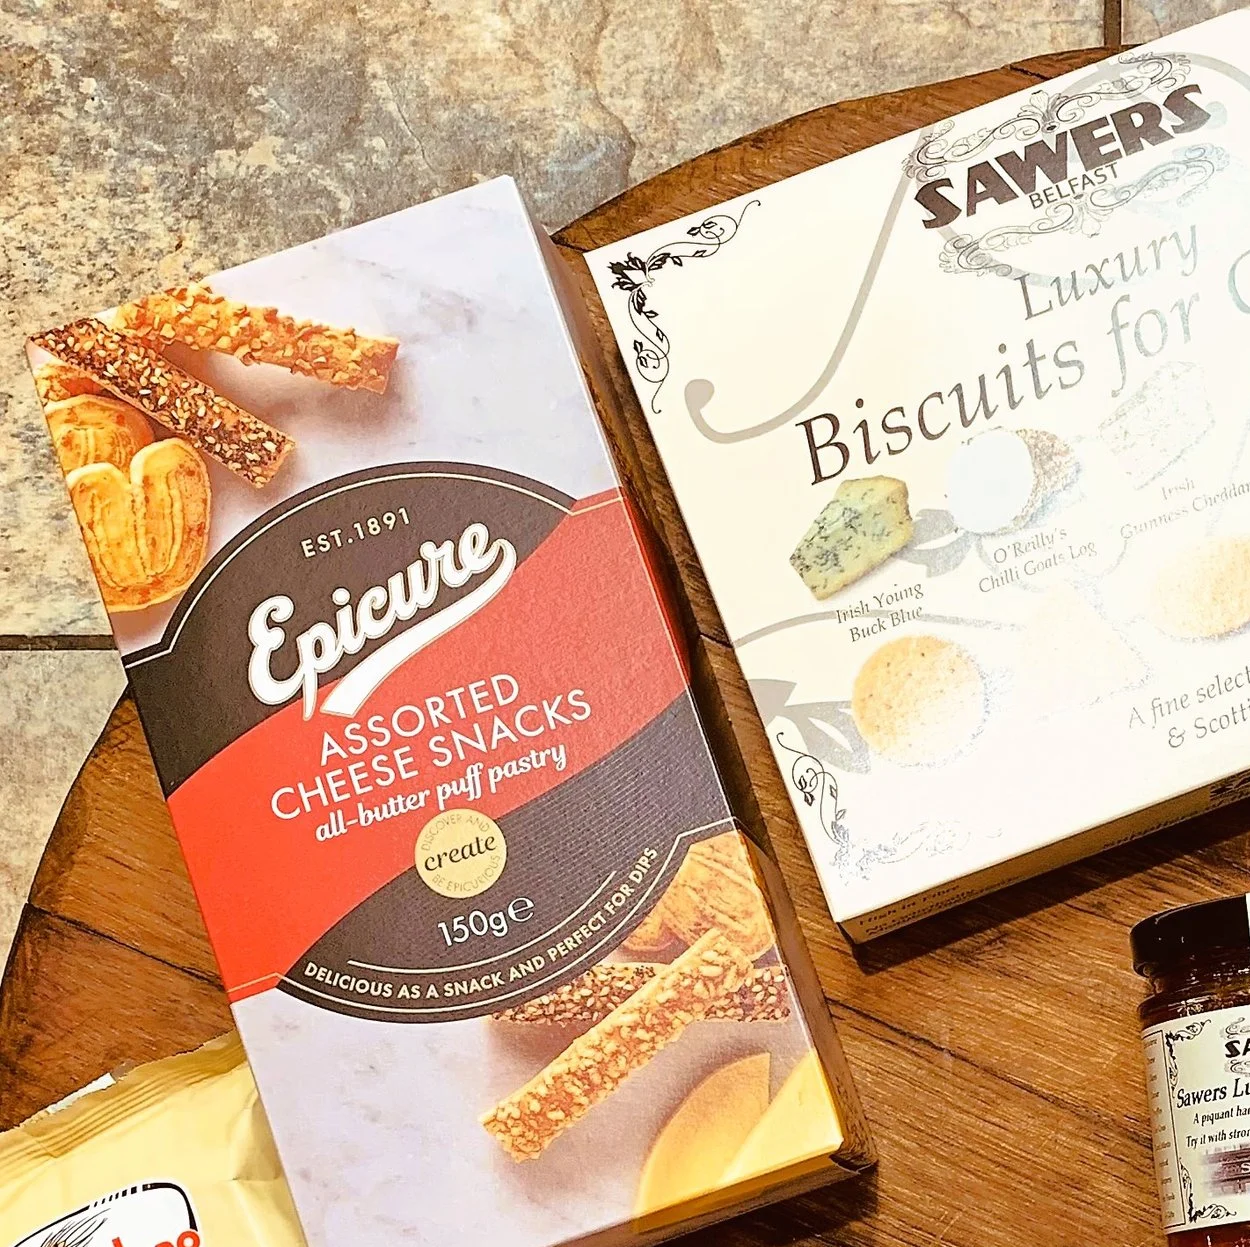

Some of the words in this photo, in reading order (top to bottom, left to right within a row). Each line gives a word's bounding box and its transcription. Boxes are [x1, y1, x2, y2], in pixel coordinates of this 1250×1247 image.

[915, 84, 1211, 229] SAWERS
[1030, 163, 1120, 209] BELFAST
[1013, 222, 1201, 321] Luxury
[795, 339, 1085, 485] Biscuits
[1107, 290, 1200, 397] for
[301, 507, 411, 558] EST.1891
[978, 567, 1019, 594] Chilli
[1024, 553, 1065, 576] Goats
[1069, 542, 1097, 560] Log
[248, 522, 517, 720] Epicure
[836, 601, 870, 624] Irish
[849, 618, 887, 642] Buck
[890, 606, 923, 627] Blue
[320, 674, 519, 766] ASSORTED
[1128, 707, 1145, 729] A
[1150, 692, 1191, 730] fine
[270, 745, 419, 820] CHEESE
[428, 688, 592, 767] SNACKS
[1168, 727, 1185, 749] &
[314, 788, 430, 842] all-butter
[436, 762, 484, 810] puff
[488, 743, 568, 794] pastry
[424, 836, 497, 871] create
[304, 961, 393, 999] DELICIOUS
[397, 984, 421, 1000] AS
[425, 983, 440, 999] A
[443, 971, 504, 997] SNACK
[509, 955, 546, 983] AND
[547, 911, 608, 963] PERFECT
[604, 883, 636, 917] FOR
[630, 847, 659, 886] DIPS
[1176, 1083, 1227, 1109] Sawers
[1193, 1113, 1200, 1124] A
[1201, 1109, 1234, 1128] piquant
[1185, 1136, 1198, 1149] Try
[1208, 1128, 1227, 1144] with
